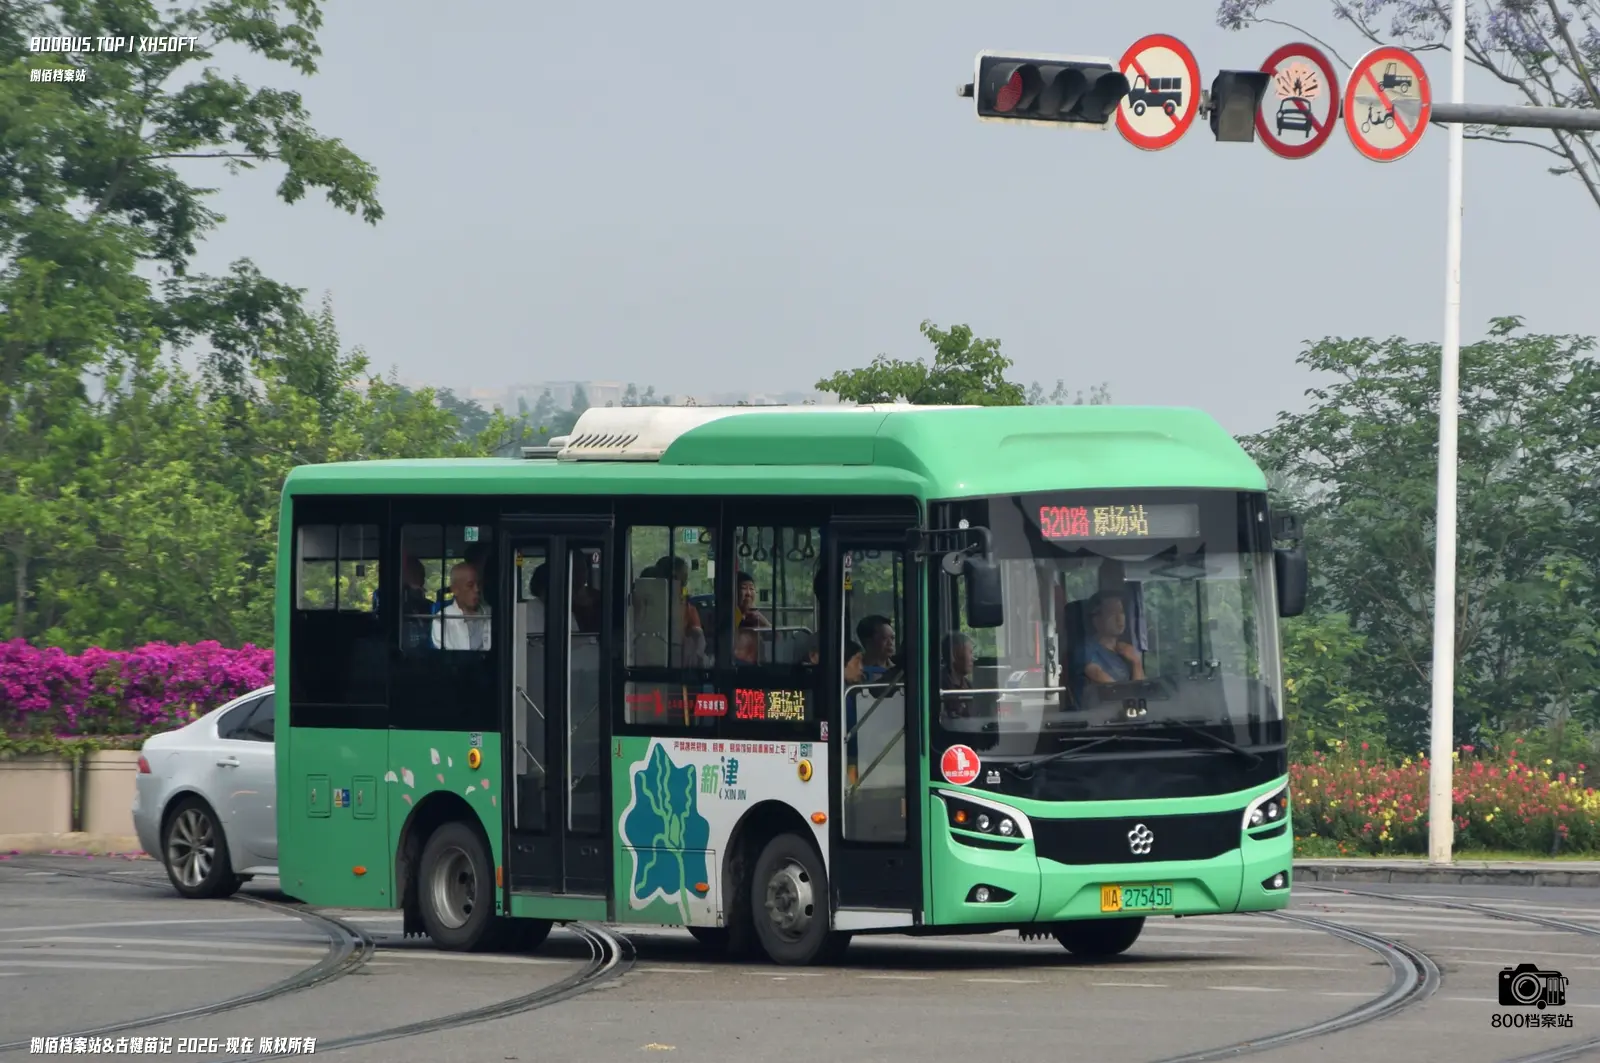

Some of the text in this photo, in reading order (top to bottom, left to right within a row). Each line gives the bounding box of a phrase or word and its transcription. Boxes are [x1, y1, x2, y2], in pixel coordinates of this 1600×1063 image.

[1039, 505, 1090, 537] 520路
[734, 688, 765, 720] 520路
[700, 755, 740, 799] 新津
